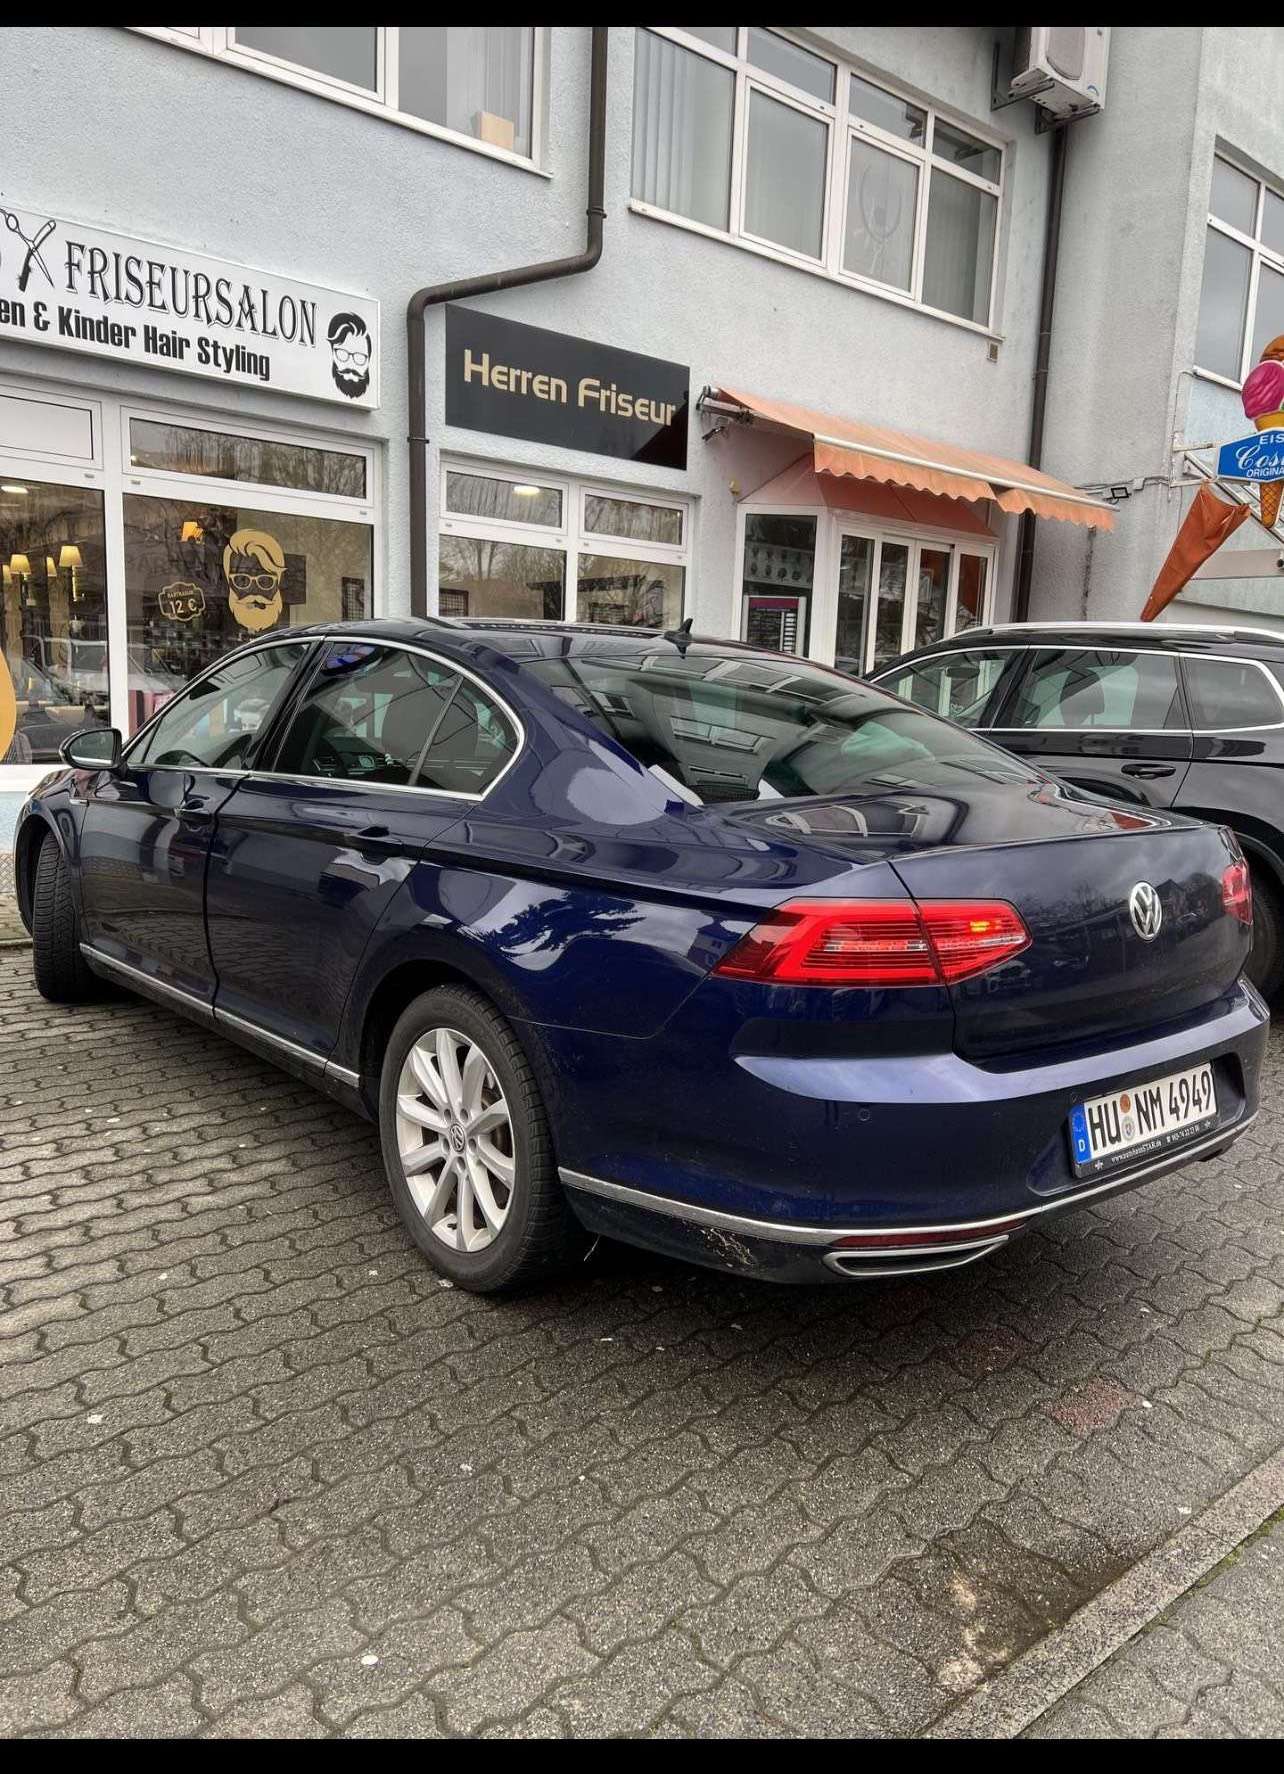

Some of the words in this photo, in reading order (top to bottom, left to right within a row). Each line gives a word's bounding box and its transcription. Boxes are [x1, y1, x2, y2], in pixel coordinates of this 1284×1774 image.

[64, 240, 319, 347] FRISEURSALON
[33, 301, 51, 331] &
[58, 305, 137, 349] Kinder
[143, 324, 191, 361] Hair
[197, 337, 271, 382] Styling
[463, 348, 568, 403] Herren
[577, 377, 676, 427] Friseur
[1259, 434, 1284, 445] EIS
[1078, 1139, 1086, 1152] D
[1088, 1101, 1121, 1151] HU
[1134, 1086, 1165, 1135] NM
[1168, 1070, 1211, 1121] 4949
